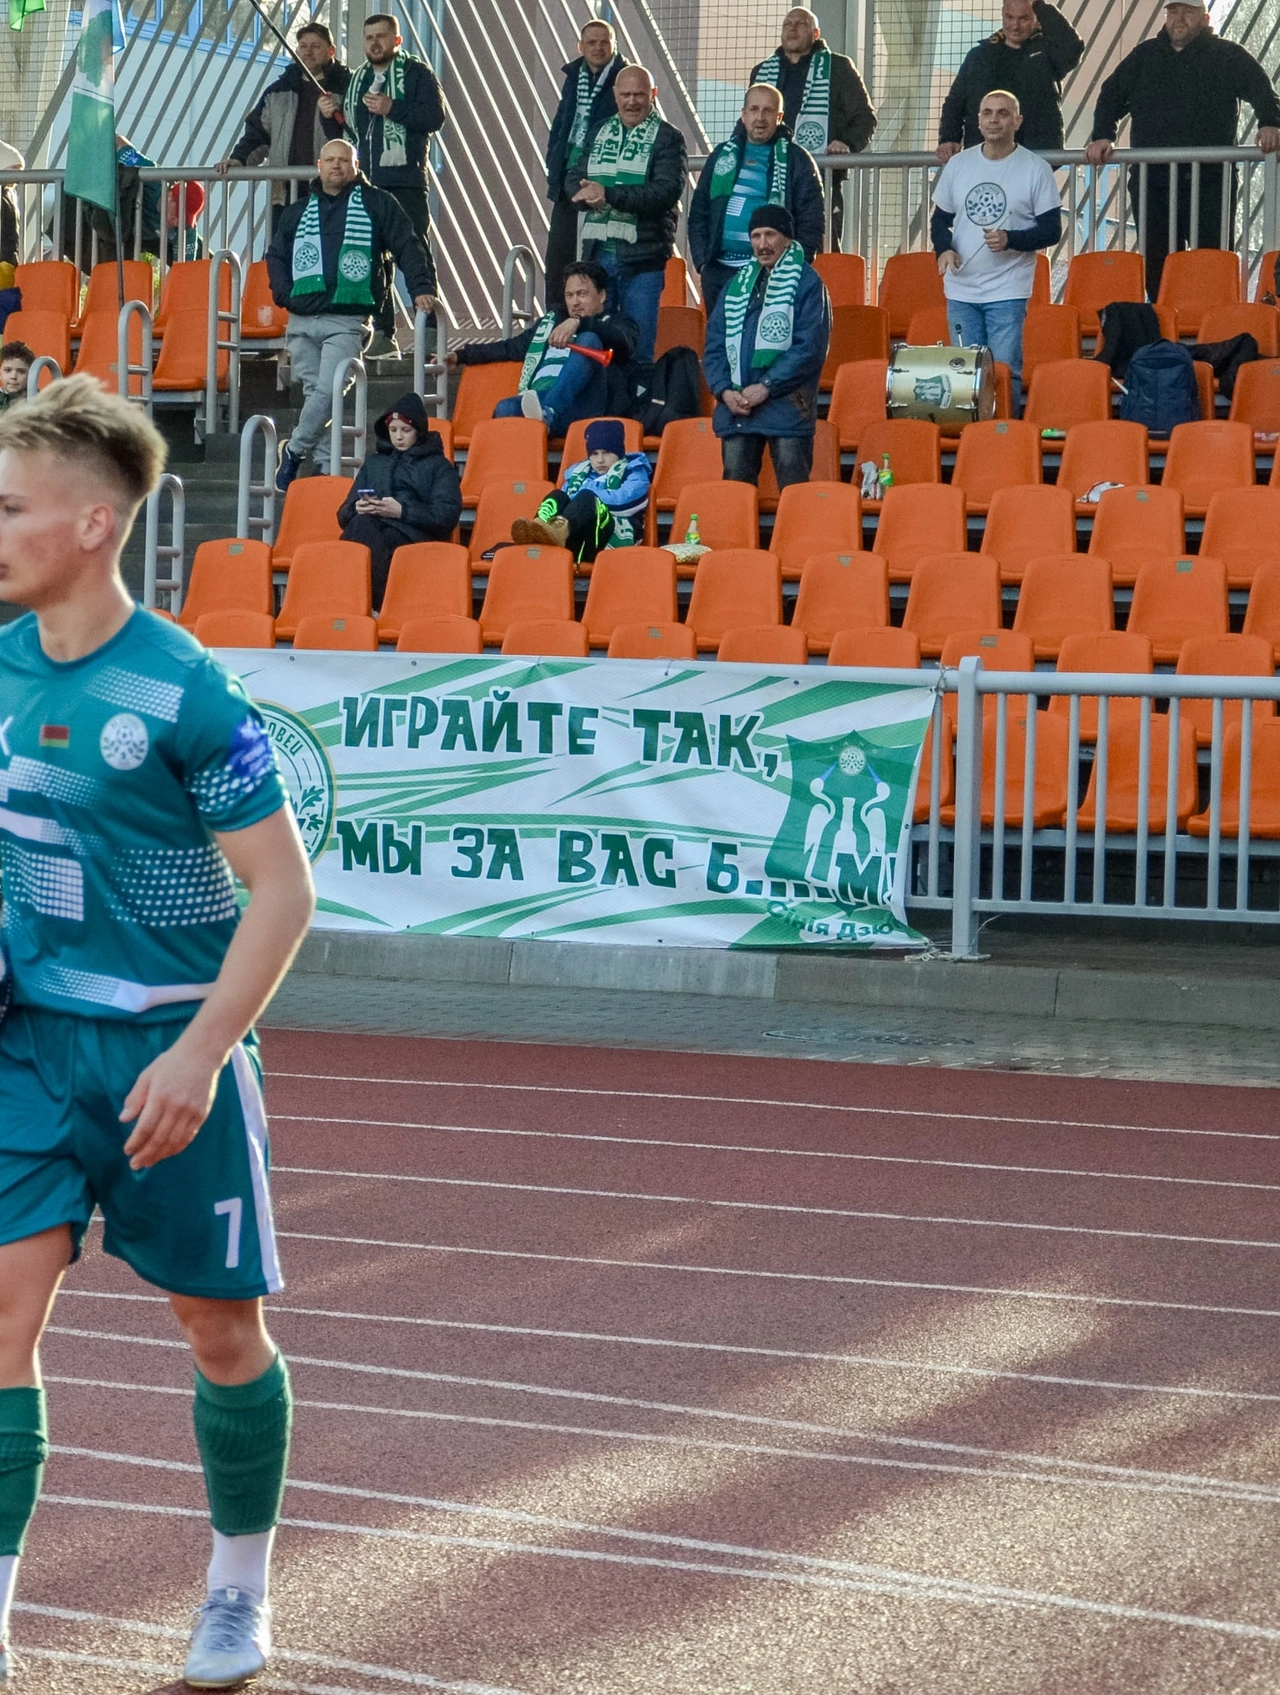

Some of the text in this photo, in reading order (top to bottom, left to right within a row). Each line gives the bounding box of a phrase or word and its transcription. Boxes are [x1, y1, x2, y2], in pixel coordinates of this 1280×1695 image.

[268, 722, 304, 757] ОВЕЦ
[342, 690, 600, 756] ИГРАЙТЕ
[633, 708, 778, 778] ТАК,
[336, 820, 422, 876] МЫ
[451, 827, 524, 881] ЗА
[558, 830, 677, 888] ВАС
